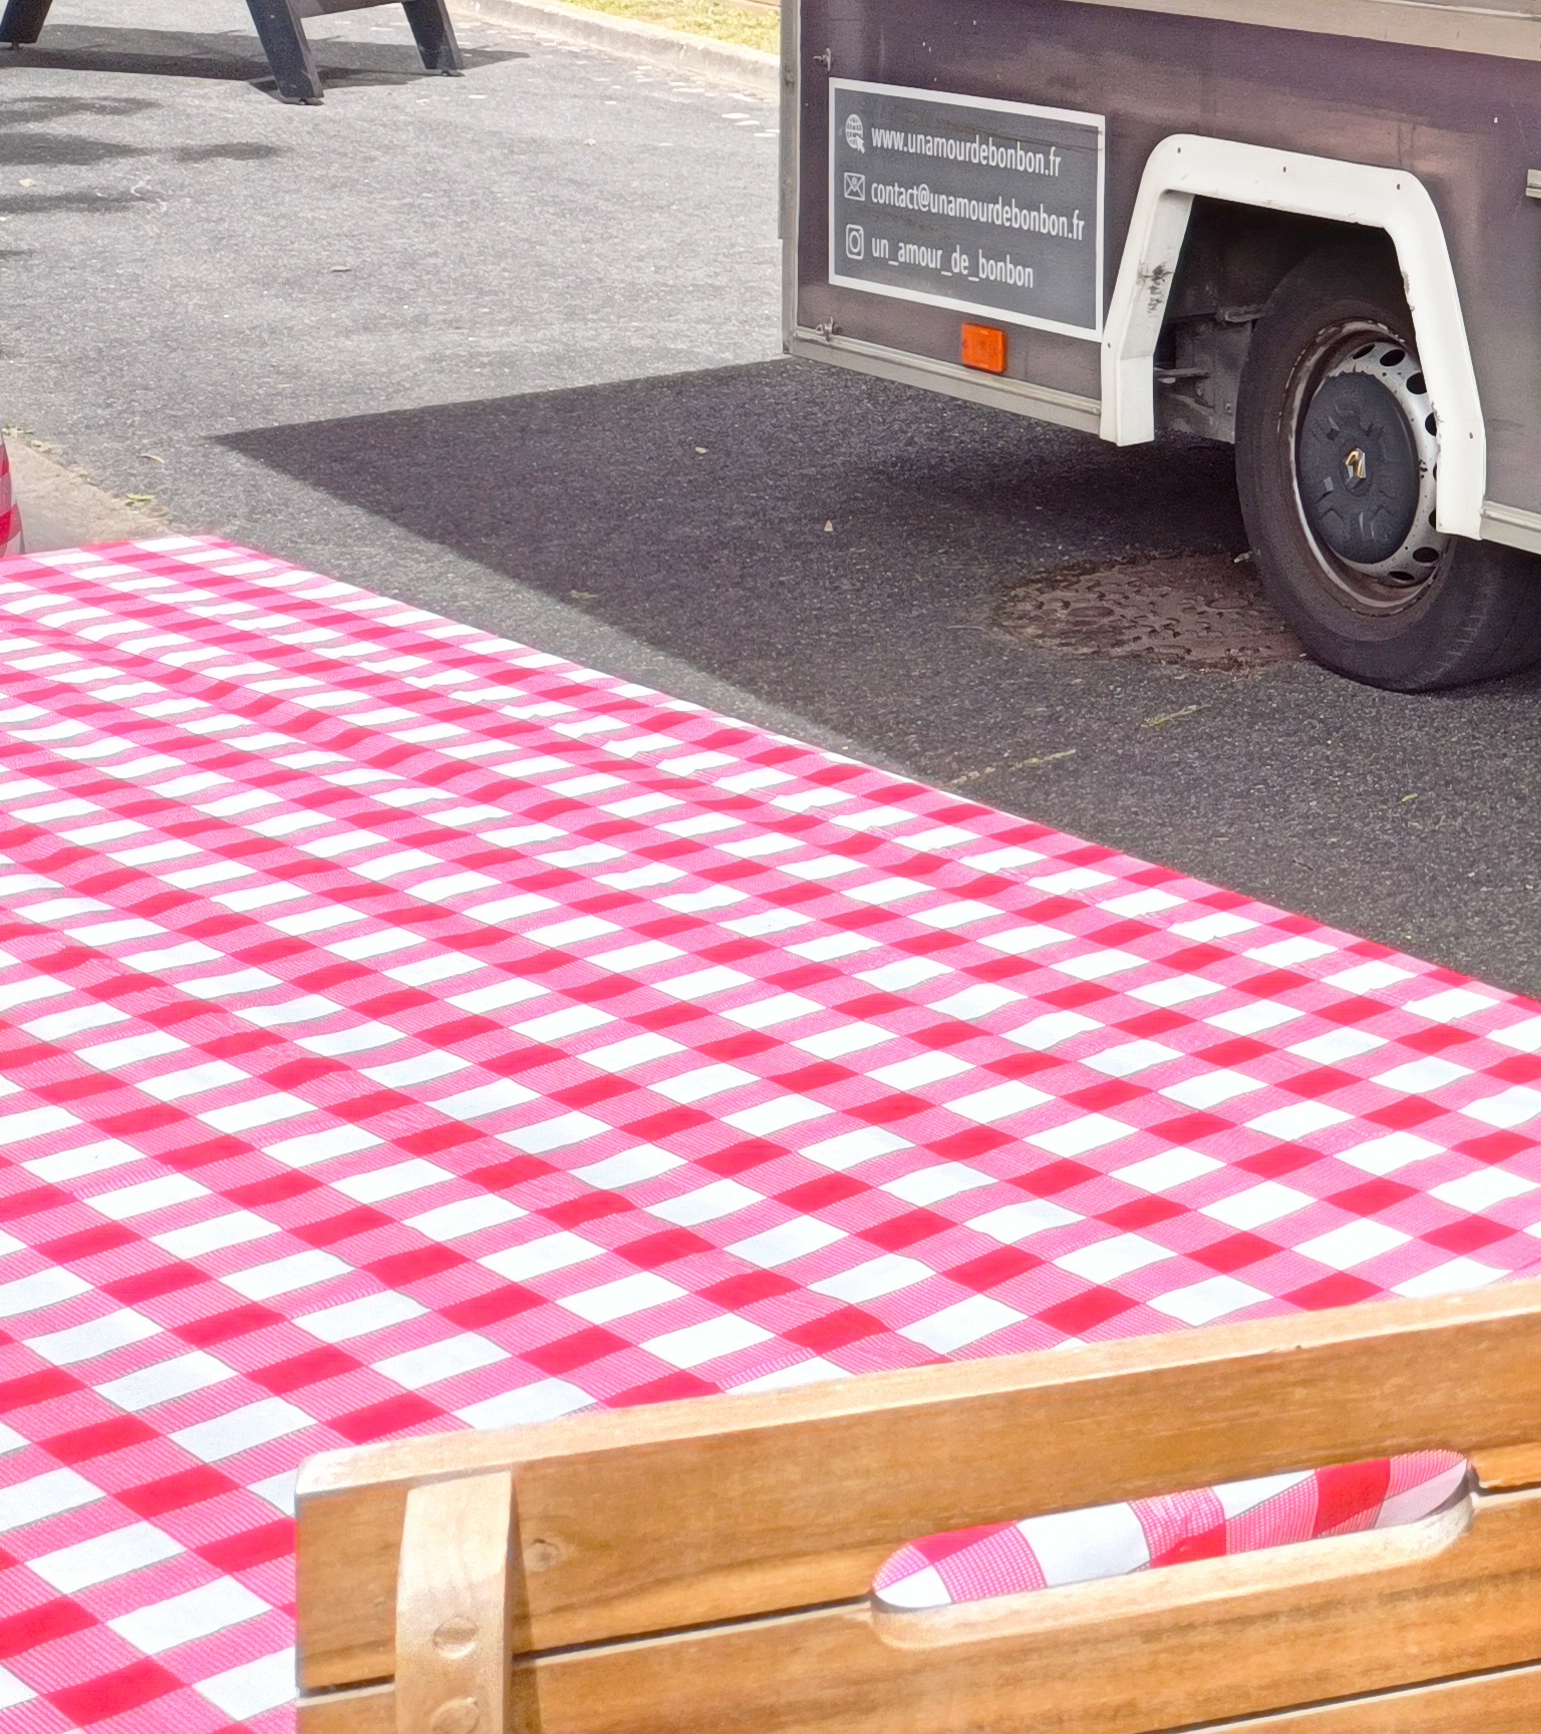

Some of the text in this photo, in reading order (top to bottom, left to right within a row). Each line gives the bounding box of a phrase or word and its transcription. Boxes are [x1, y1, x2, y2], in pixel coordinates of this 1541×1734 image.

[871, 126, 1061, 177] www.unamourdebonbon.fr
[871, 181, 1085, 241] contact@unamourdebonbon.fr
[871, 236, 1034, 289] un_amour_de_bonbon
